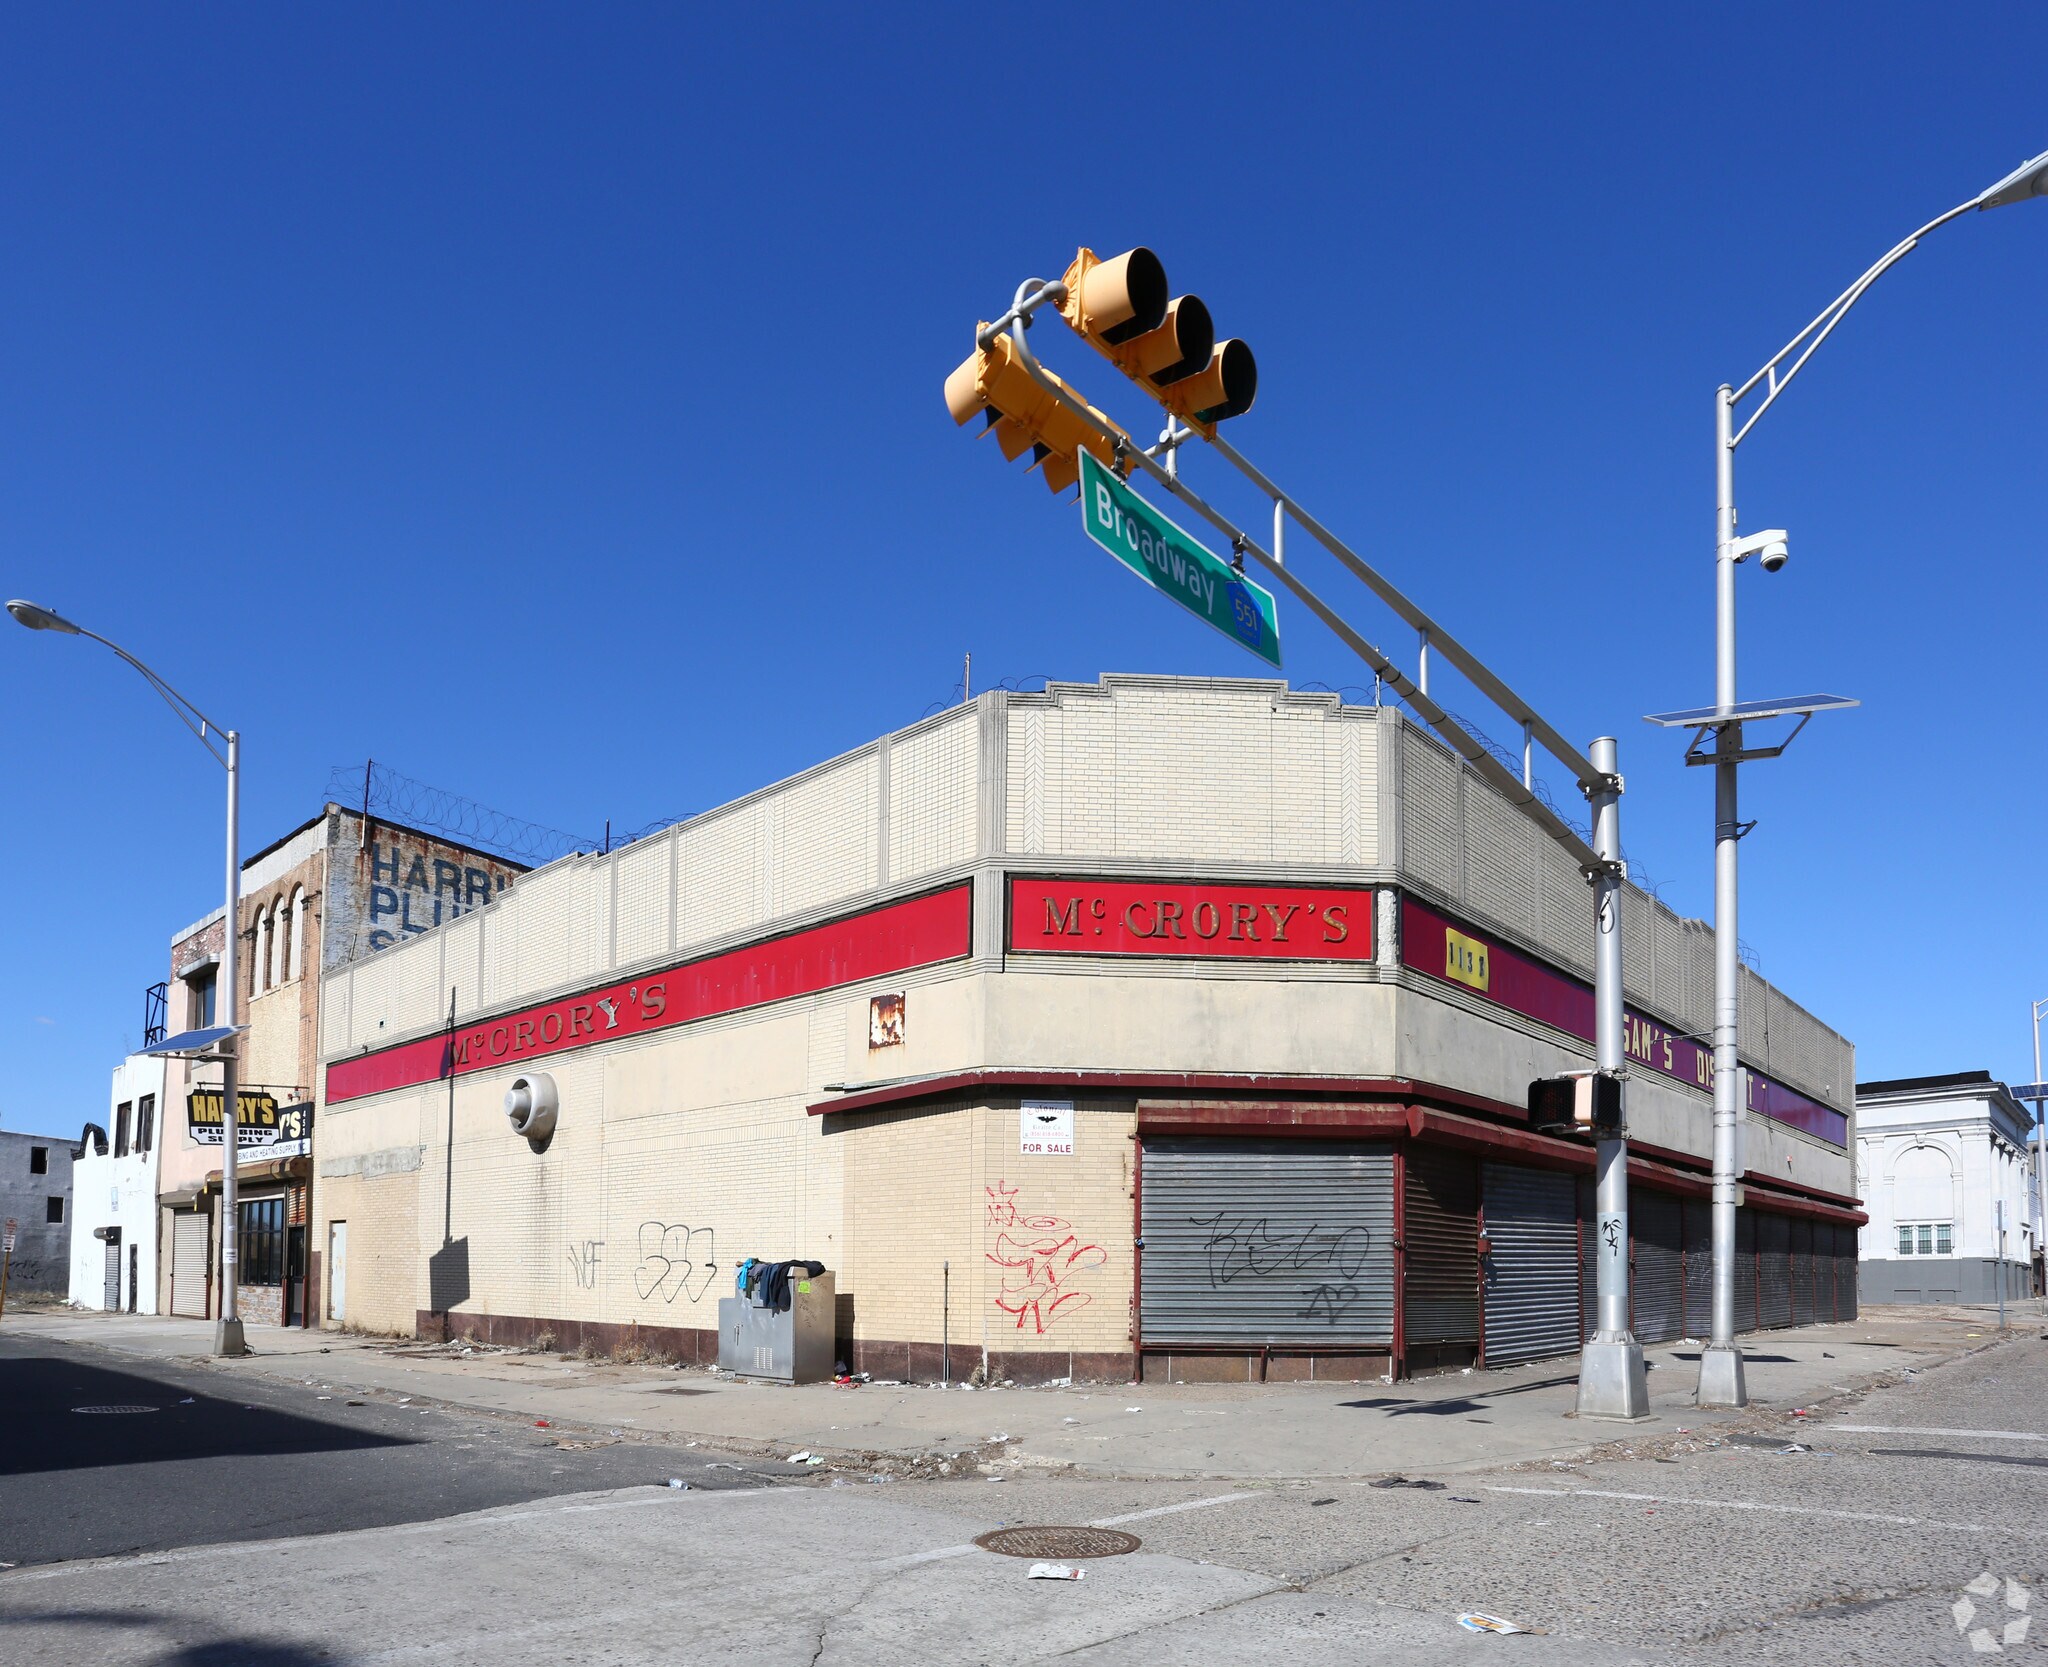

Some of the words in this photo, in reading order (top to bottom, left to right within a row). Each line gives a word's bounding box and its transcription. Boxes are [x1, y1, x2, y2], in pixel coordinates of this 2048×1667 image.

[1096, 481, 1214, 615] Broadway
[1235, 598, 1257, 631] 551
[192, 1095, 275, 1125] HARY'S
[198, 1128, 273, 1136] PLUBING
[1023, 1144, 1042, 1152] FOR
[1047, 1144, 1071, 1153] SALE
